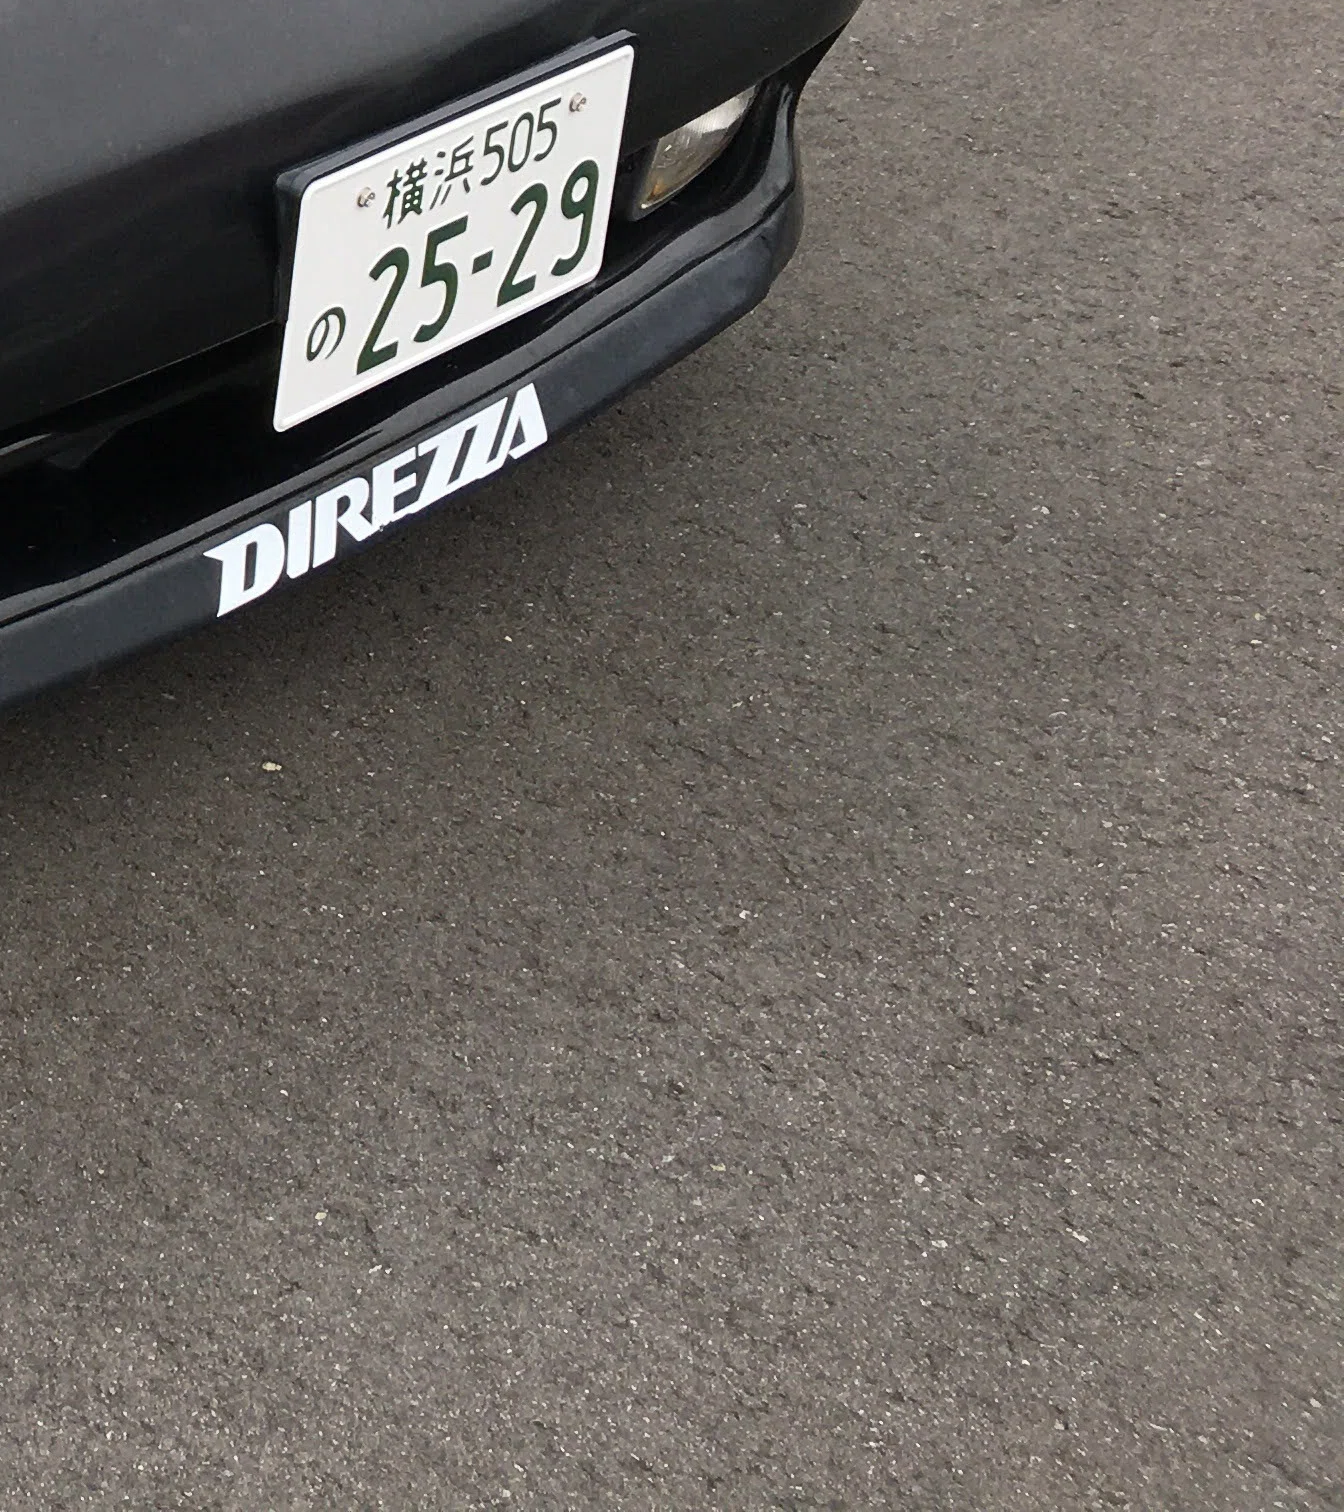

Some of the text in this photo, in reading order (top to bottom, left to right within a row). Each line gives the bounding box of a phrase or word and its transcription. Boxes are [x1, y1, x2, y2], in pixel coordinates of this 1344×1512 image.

[305, 159, 600, 375] の 25-29
[203, 382, 549, 618] DIREZZA
